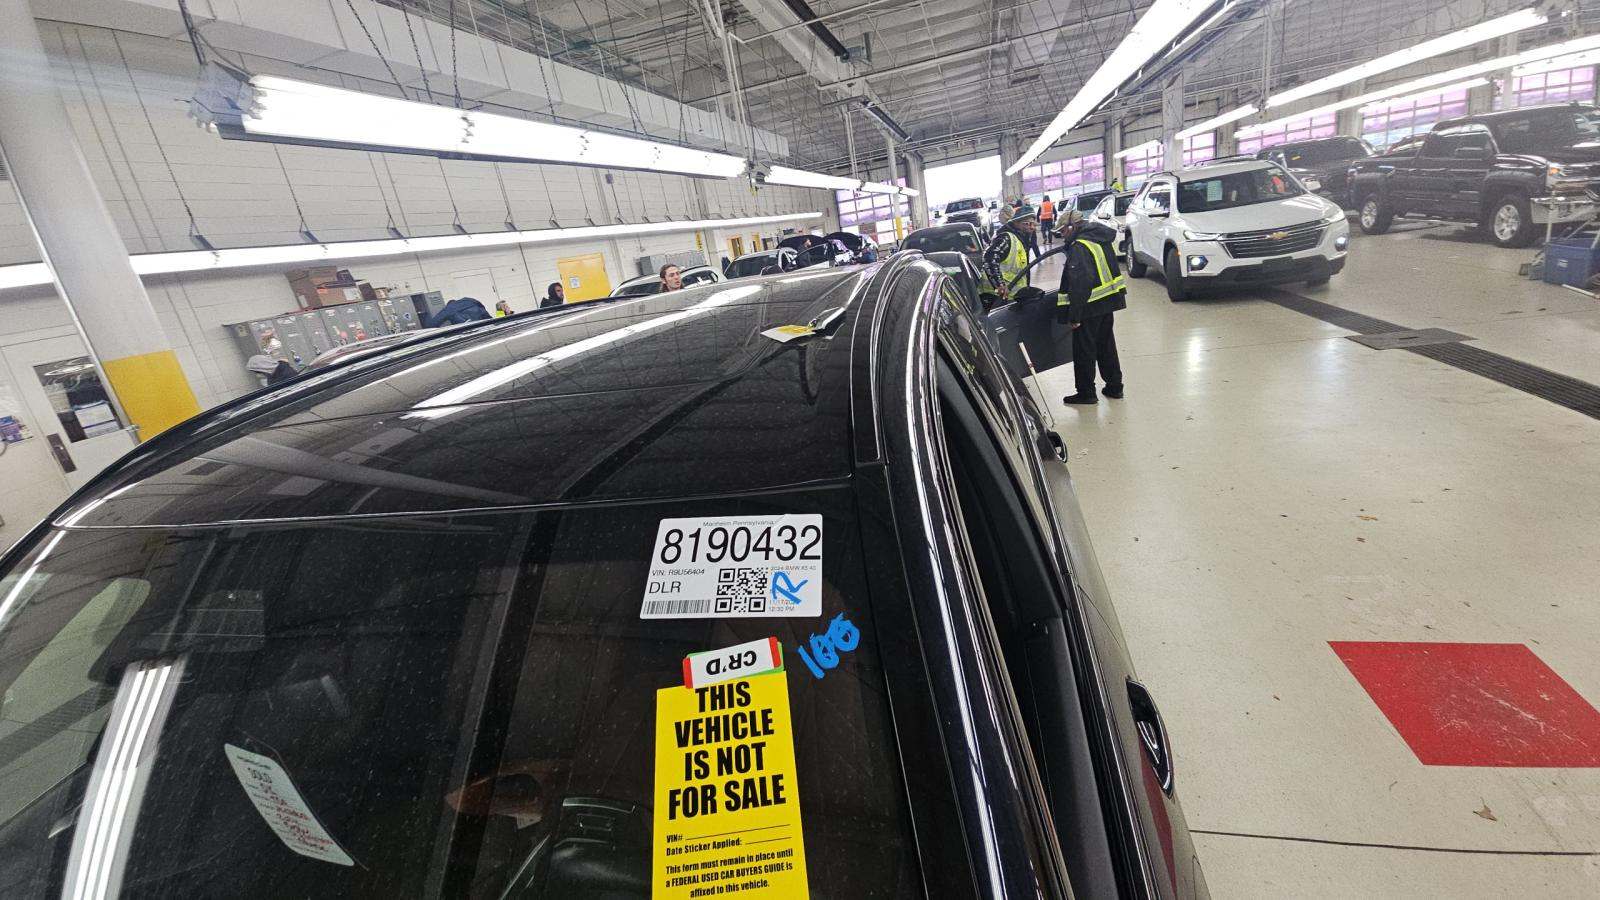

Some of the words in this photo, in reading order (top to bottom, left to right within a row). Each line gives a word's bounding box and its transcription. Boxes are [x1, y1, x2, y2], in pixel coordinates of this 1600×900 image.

[660, 524, 821, 564] 8190432
[649, 581, 681, 593] DLR
[706, 650, 757, 675] CR'D
[695, 681, 751, 713] THIS
[675, 708, 774, 748] VEHICLE
[685, 750, 710, 781] IS
[717, 742, 766, 776] NOT
[669, 784, 717, 820] FOR
[724, 774, 786, 812] SALE
[666, 834, 683, 843] VIN#
[666, 846, 682, 856] Date
[685, 842, 710, 853] Sticker
[712, 837, 742, 849] Applied:
[666, 865, 681, 875] This
[682, 862, 699, 872] form
[700, 859, 719, 869] must
[720, 855, 745, 866] remain
[747, 853, 754, 863] in
[755, 850, 775, 863] place
[777, 848, 793, 859] until
[666, 879, 670, 887] a
[672, 874, 699, 887] FEDERAL
[701, 872, 719, 883] USED
[720, 869, 734, 880] CAR
[736, 866, 762, 878] BUYERS
[764, 863, 784, 875] GUIDE
[786, 861, 793, 871] is
[690, 885, 715, 898] affixed
[717, 884, 724, 894] to
[725, 882, 739, 893] this
[741, 878, 770, 890] vehicle.
